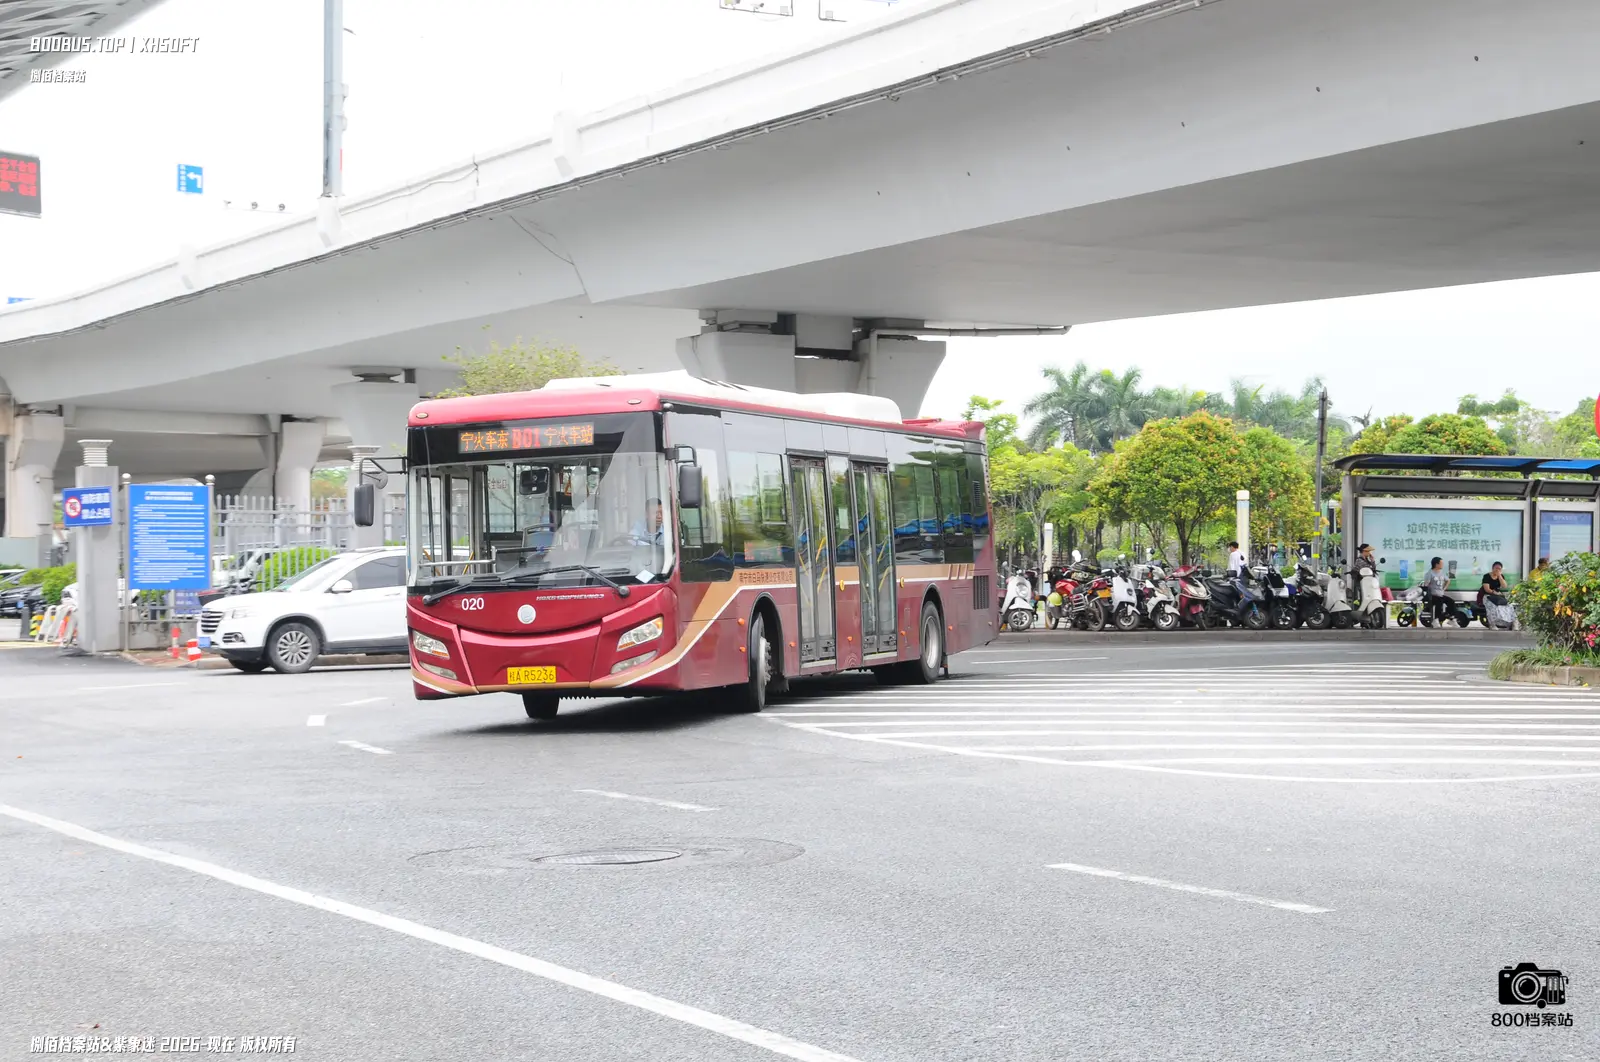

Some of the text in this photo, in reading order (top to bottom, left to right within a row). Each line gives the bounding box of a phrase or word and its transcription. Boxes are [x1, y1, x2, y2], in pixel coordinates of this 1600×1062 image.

[460, 424, 593, 452] 宁火车东 B01 宁火车站
[1407, 522, 1482, 535] 垃圾分类我能行
[1382, 537, 1502, 552] 共创卫生文明城市我先行
[461, 597, 485, 611] 020
